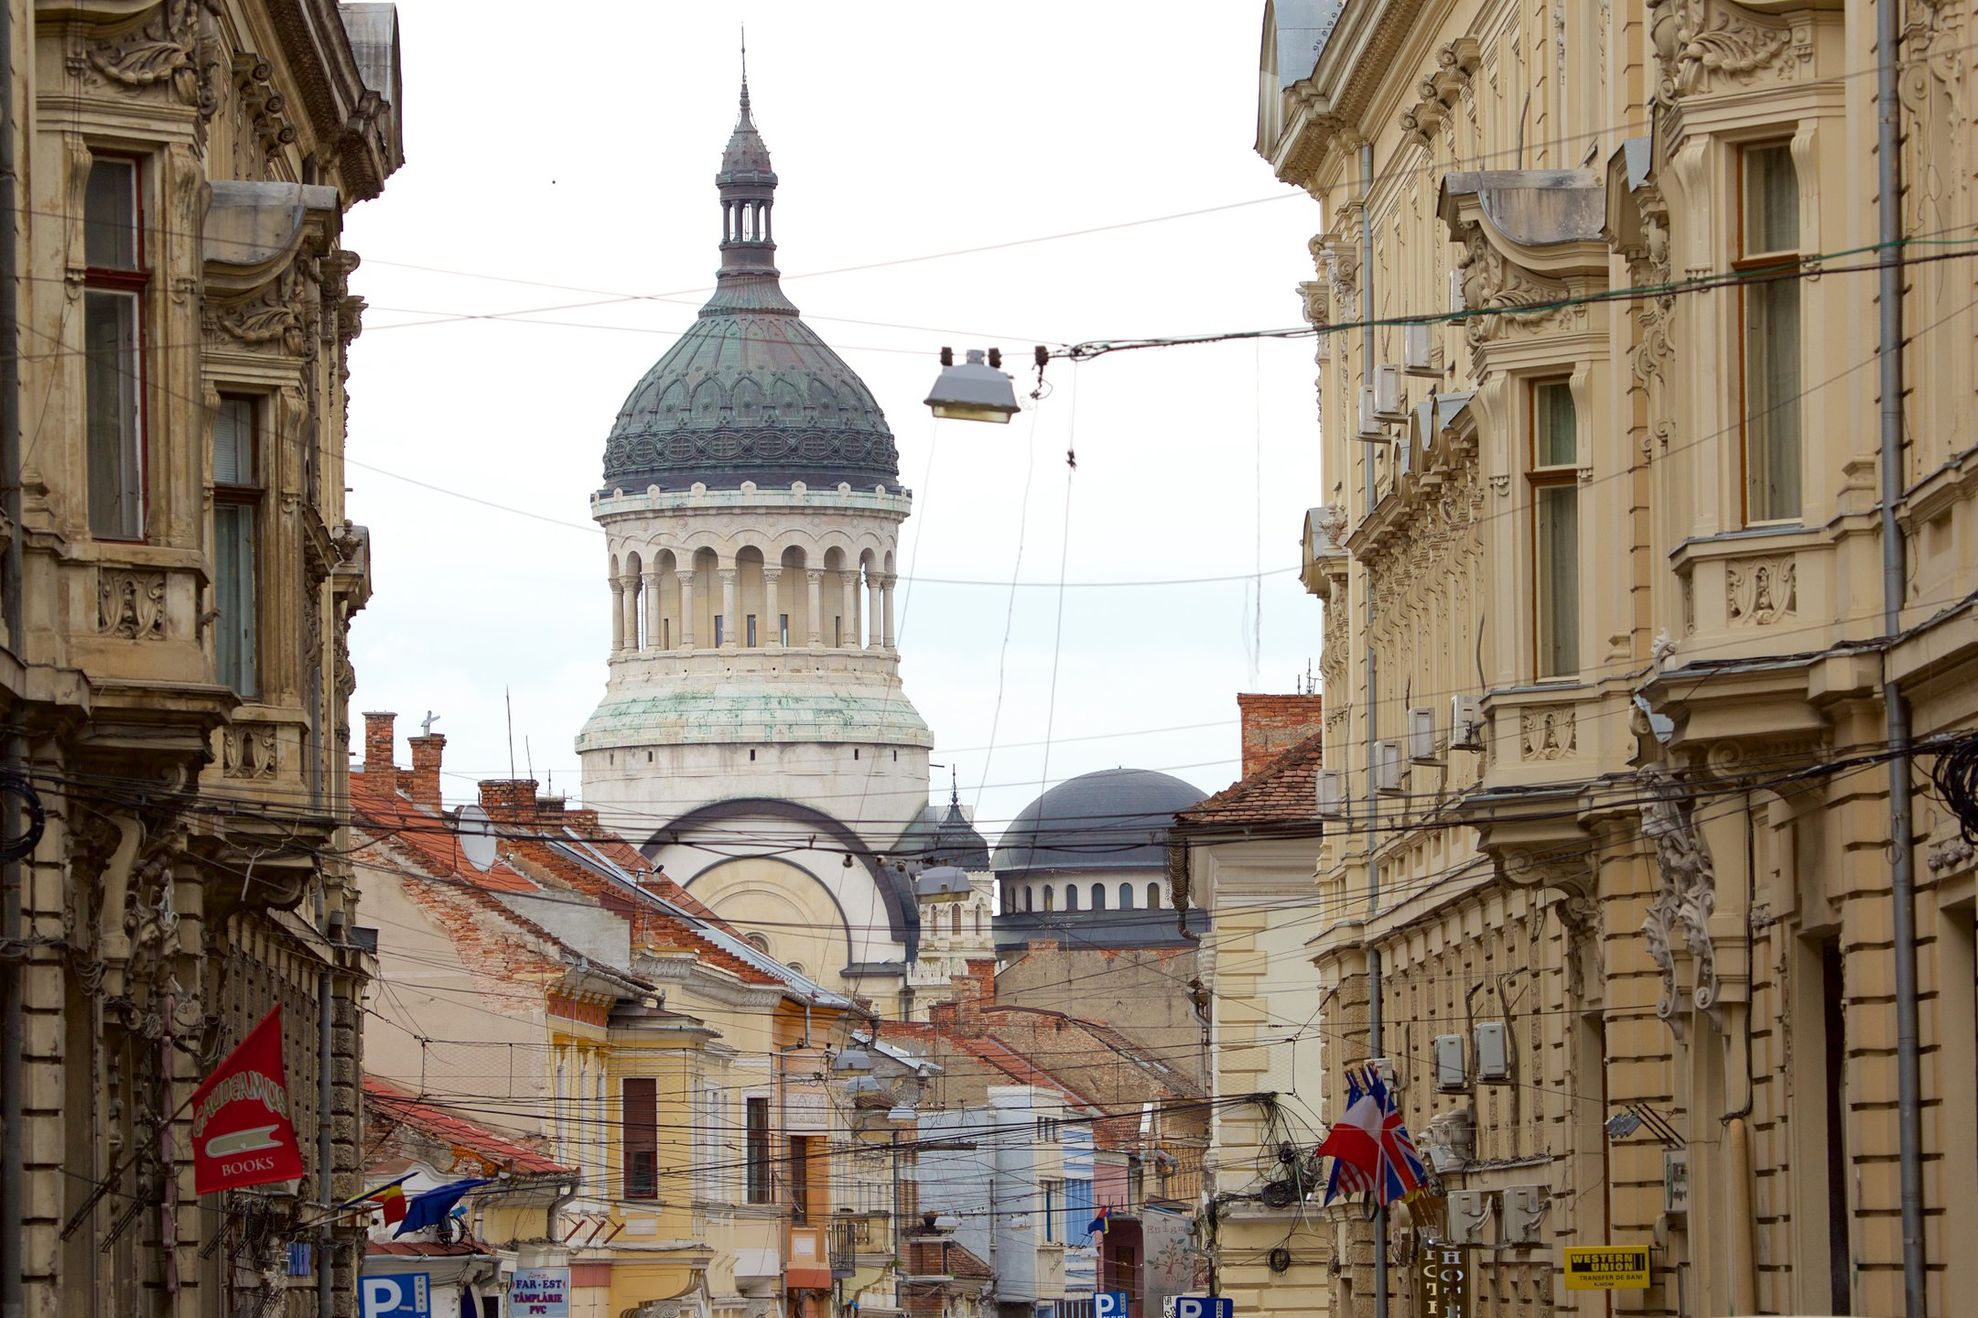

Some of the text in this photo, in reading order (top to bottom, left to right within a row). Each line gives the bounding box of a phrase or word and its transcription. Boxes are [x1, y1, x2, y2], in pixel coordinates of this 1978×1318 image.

[193, 1070, 290, 1137] GAUDEAMUS
[221, 1157, 275, 1177] BOOKS
[1572, 1254, 1633, 1264] WESTERN
[1591, 1262, 1634, 1272] UNION
[516, 1280, 562, 1289] FAR EST
[363, 1278, 402, 1318] P
[1094, 1293, 1115, 1318] P
[529, 1305, 547, 1315] PVC
[1180, 1300, 1203, 1318] P
